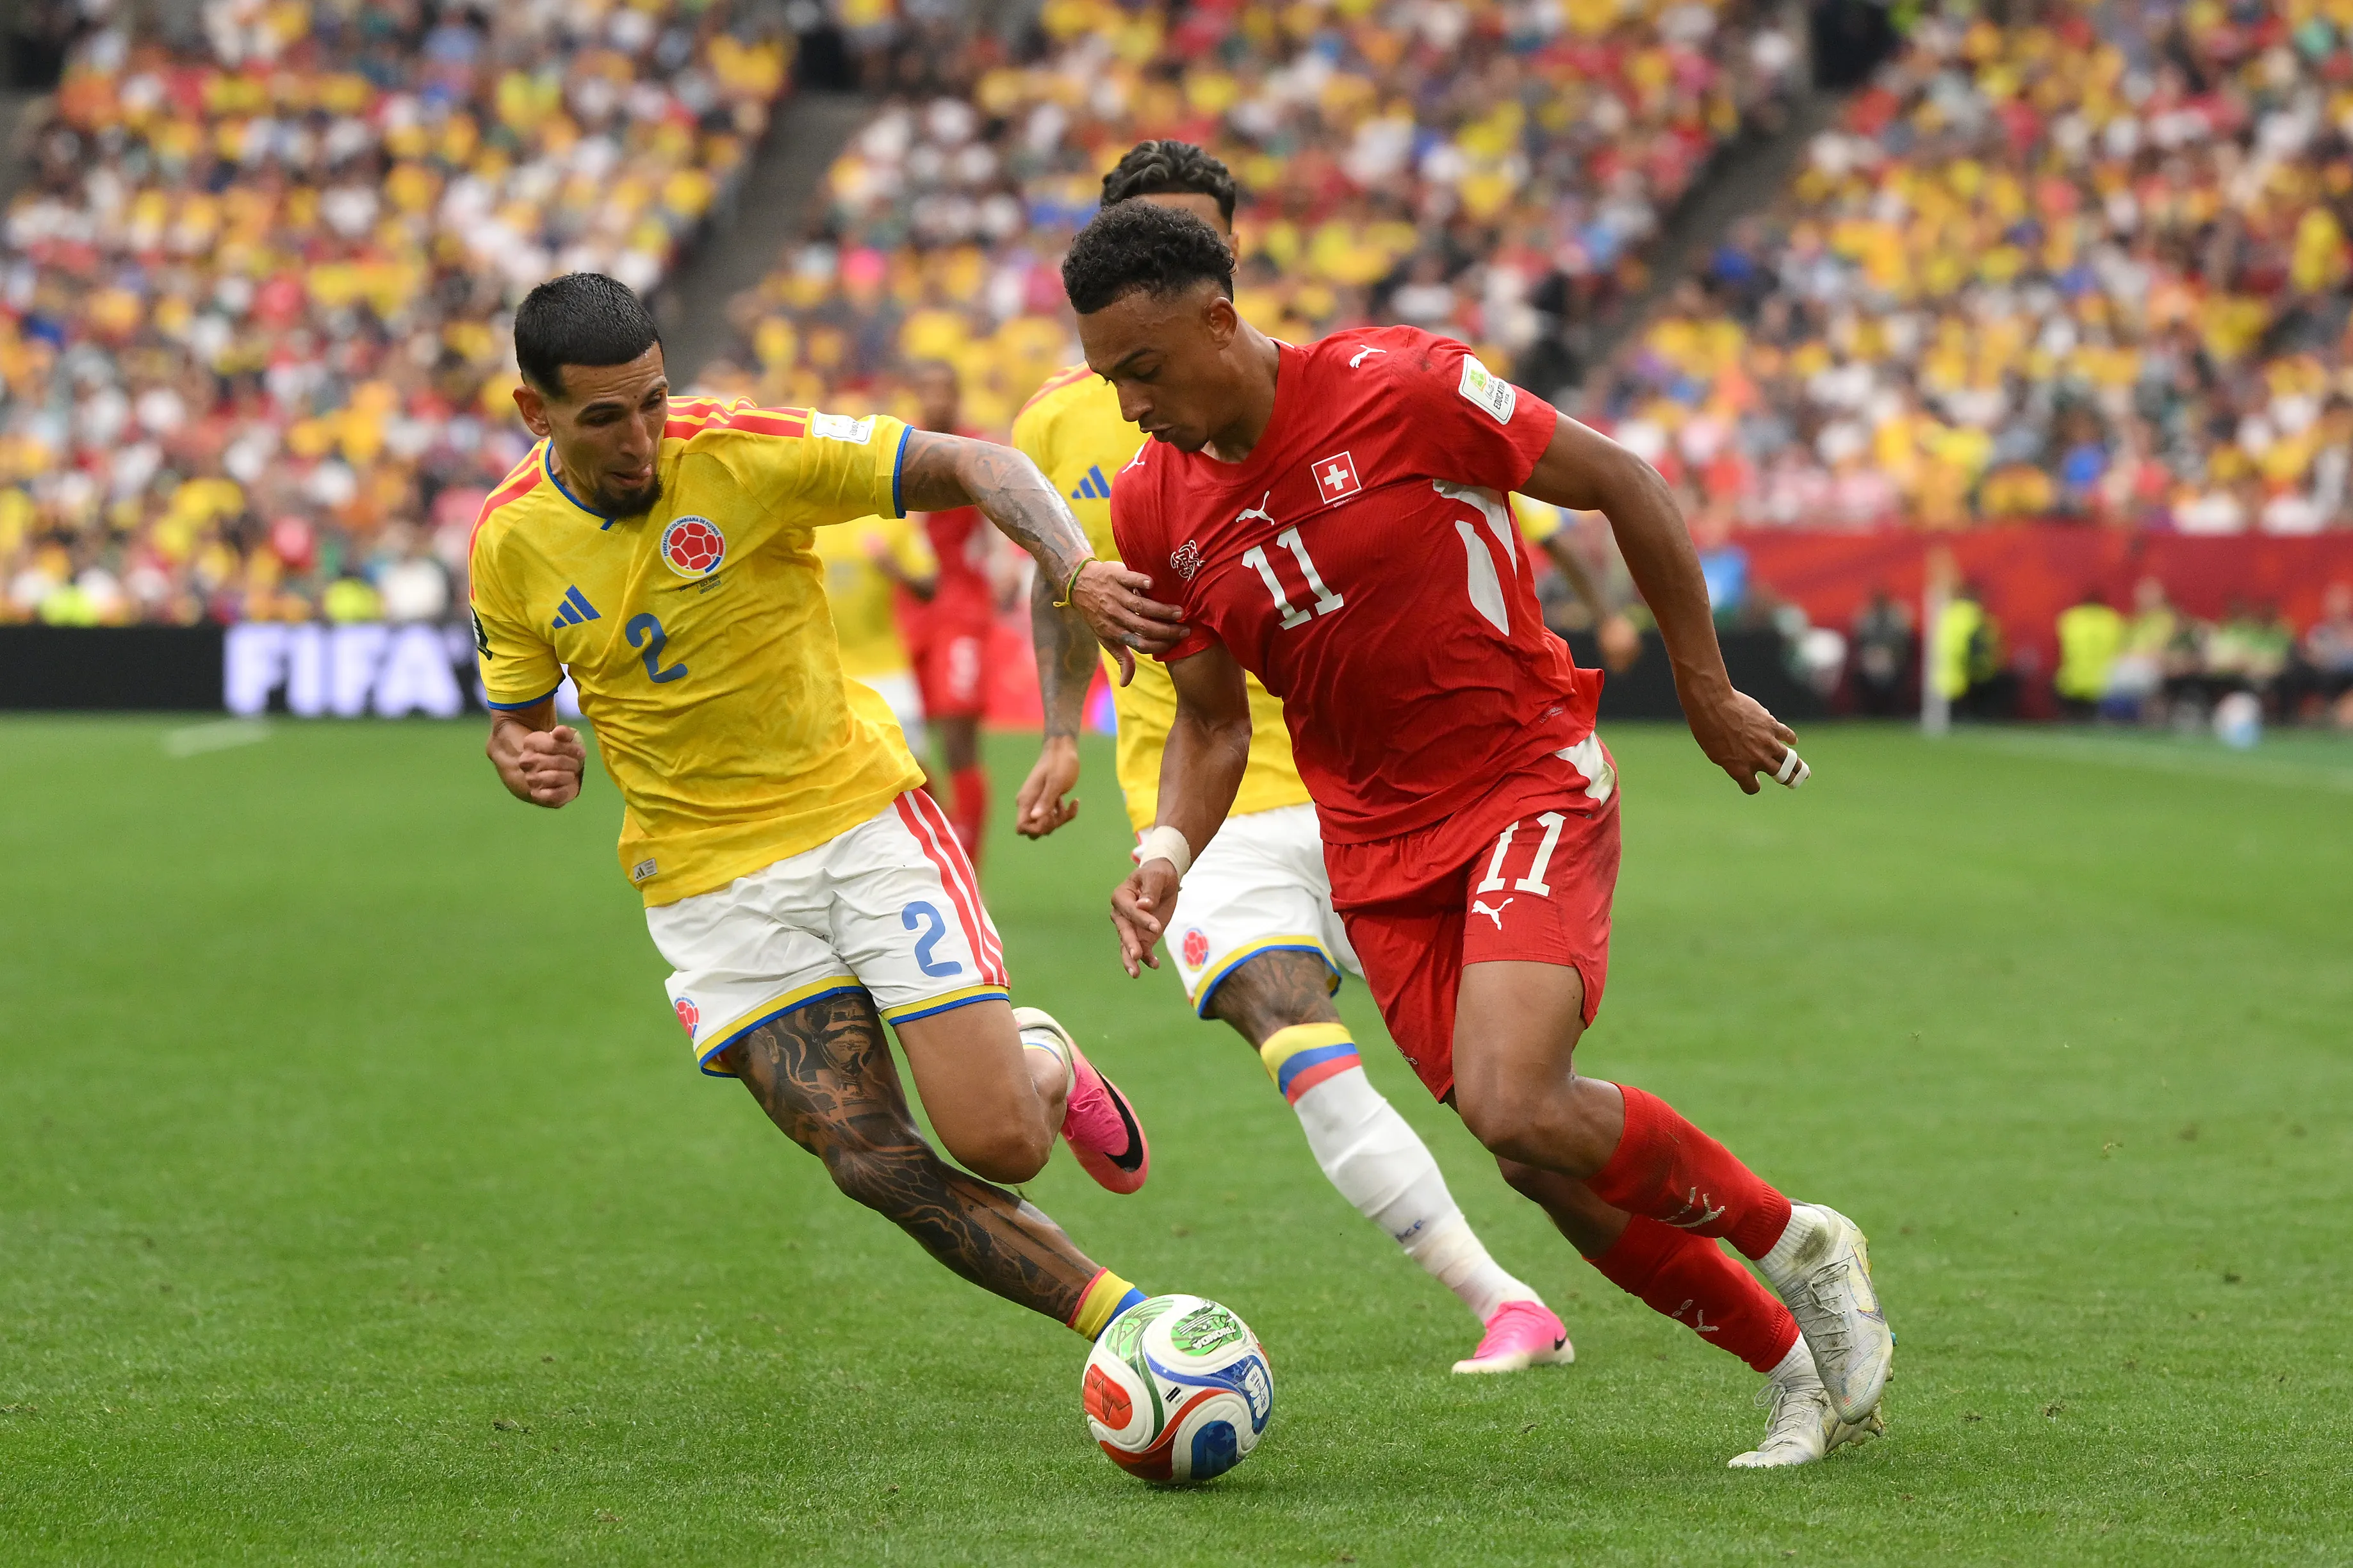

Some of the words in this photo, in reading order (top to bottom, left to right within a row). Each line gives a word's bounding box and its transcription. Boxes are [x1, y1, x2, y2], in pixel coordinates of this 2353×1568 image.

[1493, 382, 1505, 410] EDUCATIO
[670, 517, 699, 530] COLOMBIANA
[1242, 525, 1344, 630] 11
[224, 621, 463, 717] FIFA
[625, 612, 688, 683] 2
[1476, 811, 1567, 897] 11
[901, 901, 962, 977] 2
